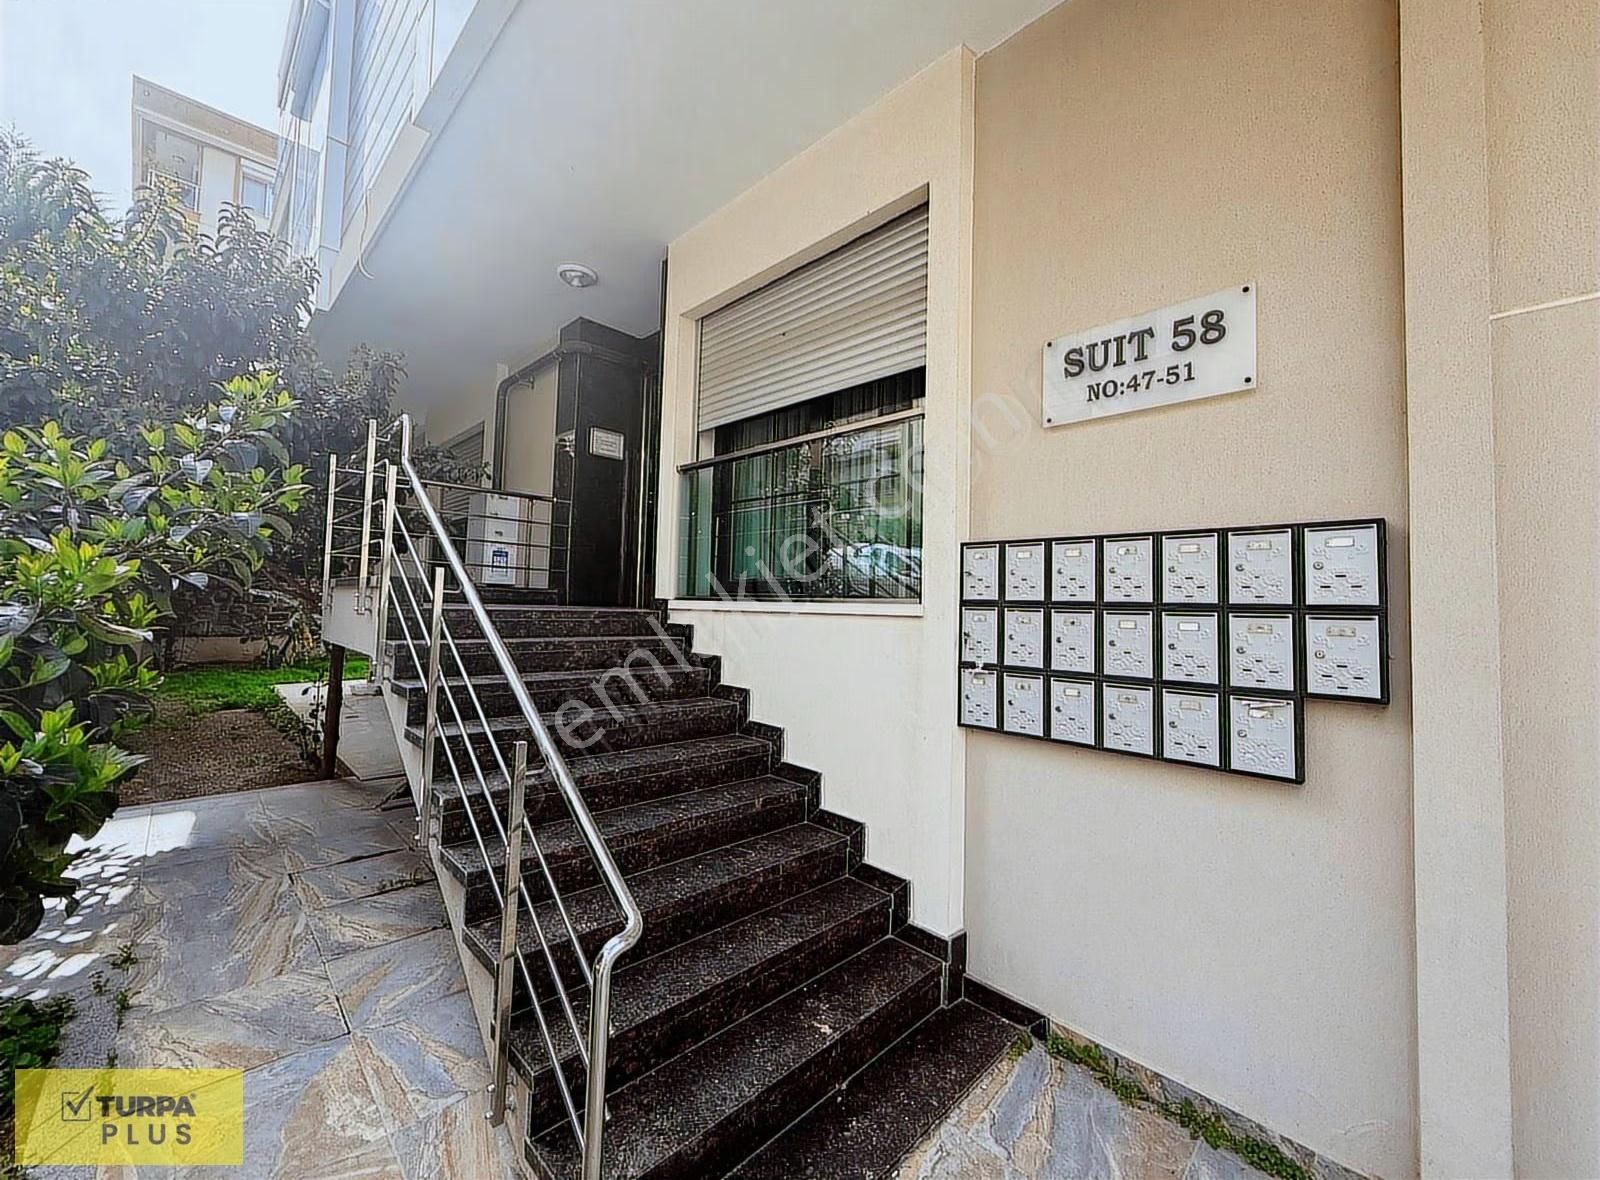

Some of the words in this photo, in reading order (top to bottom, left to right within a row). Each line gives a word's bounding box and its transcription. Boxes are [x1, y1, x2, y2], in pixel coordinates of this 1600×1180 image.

[1063, 327, 1155, 379] SUIT
[1171, 309, 1227, 352] 58
[1086, 361, 1196, 402] NO:47-51
